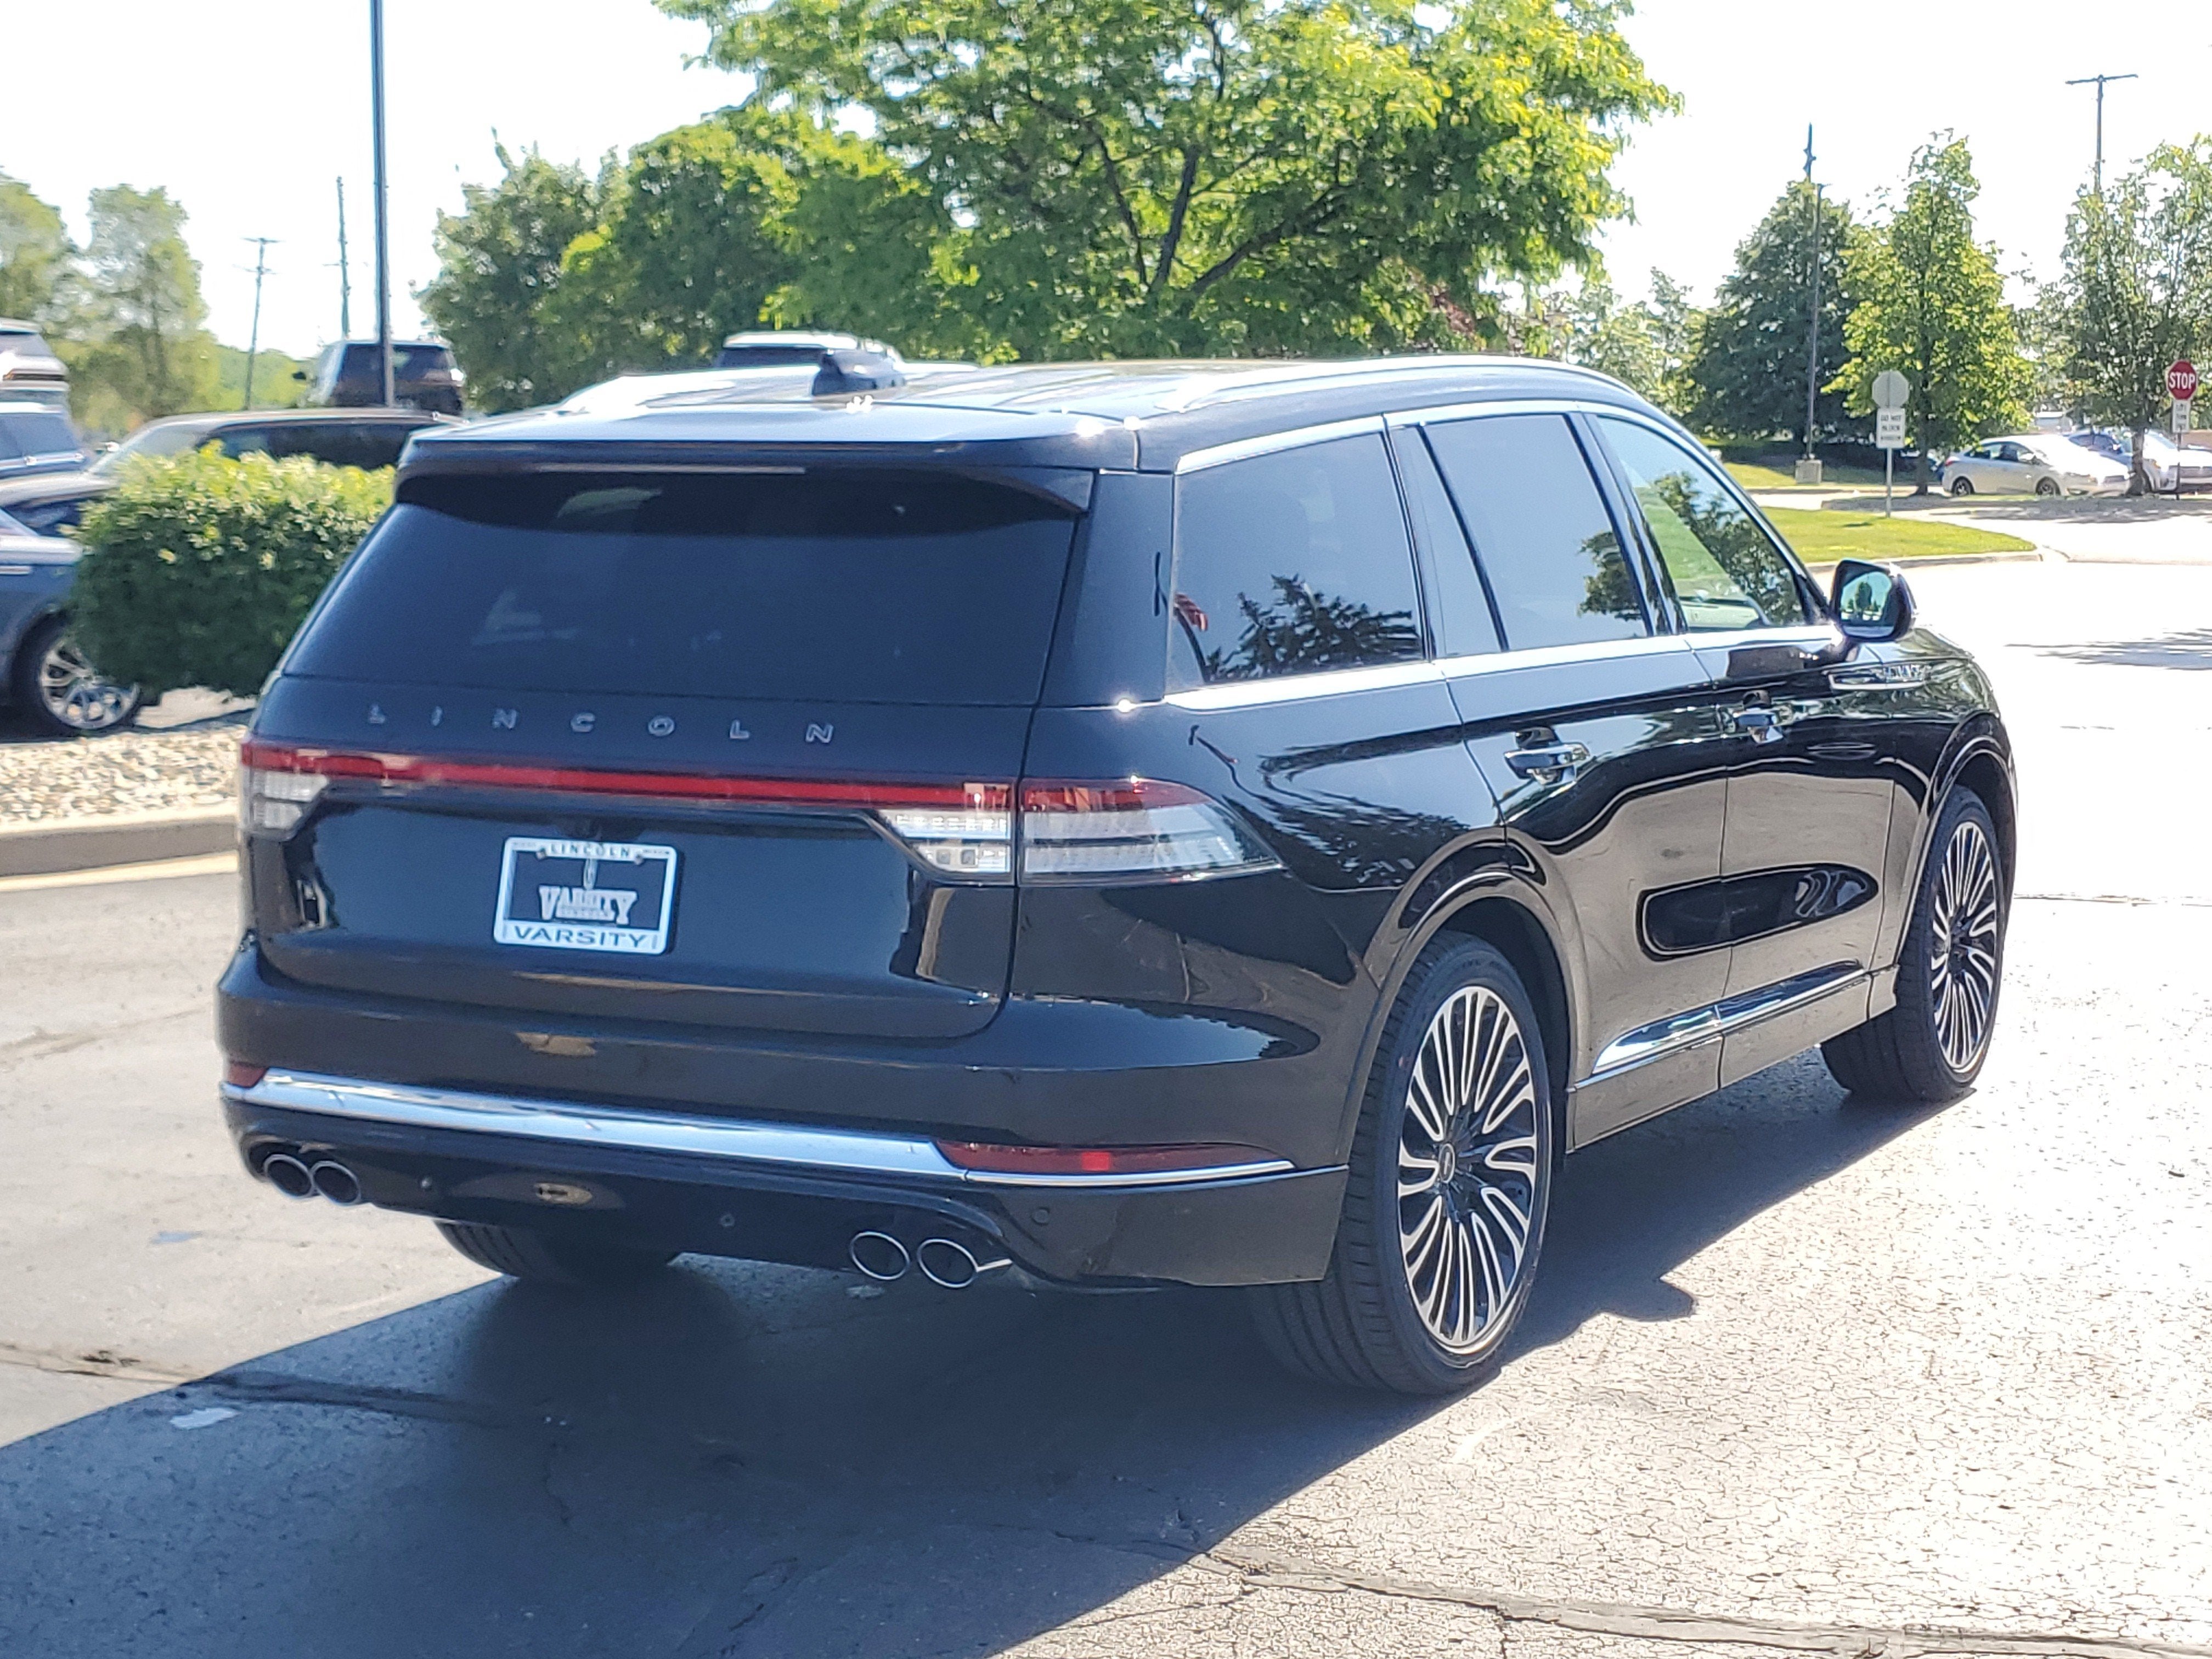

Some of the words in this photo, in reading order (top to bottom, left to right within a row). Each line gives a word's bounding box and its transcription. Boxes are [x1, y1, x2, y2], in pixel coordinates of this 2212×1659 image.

[2169, 372, 2196, 390] STOP
[369, 704, 834, 743] LINCOLN
[550, 843, 630, 857] LINCOLN
[514, 925, 647, 949] VARSITY
